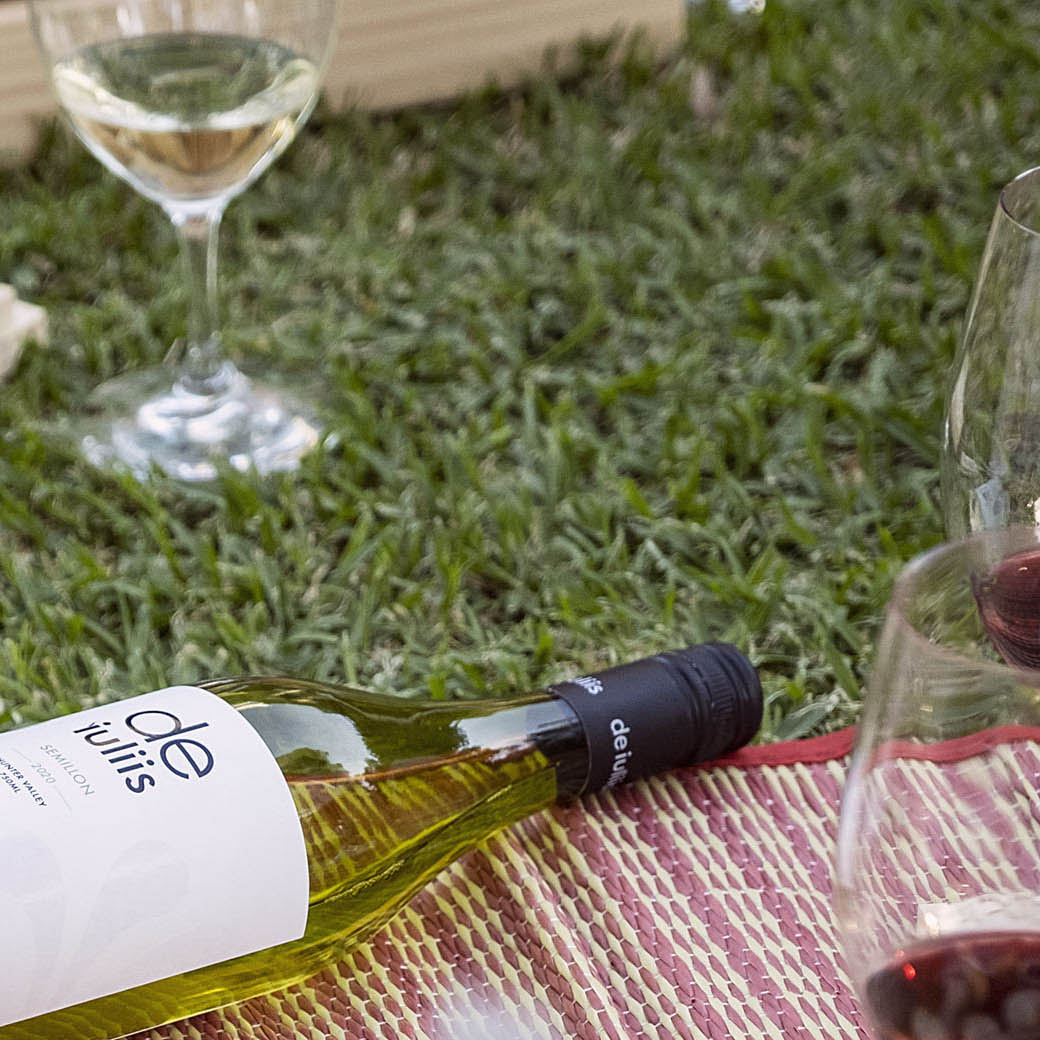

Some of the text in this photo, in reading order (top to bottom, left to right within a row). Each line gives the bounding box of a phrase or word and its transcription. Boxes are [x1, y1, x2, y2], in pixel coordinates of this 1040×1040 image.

[125, 710, 214, 779] de
[610, 718, 631, 751] de
[31, 762, 56, 784] 2020
[40, 744, 95, 796] SEMILLON
[73, 722, 155, 793] iuliis
[22, 780, 47, 806] VALLEY
